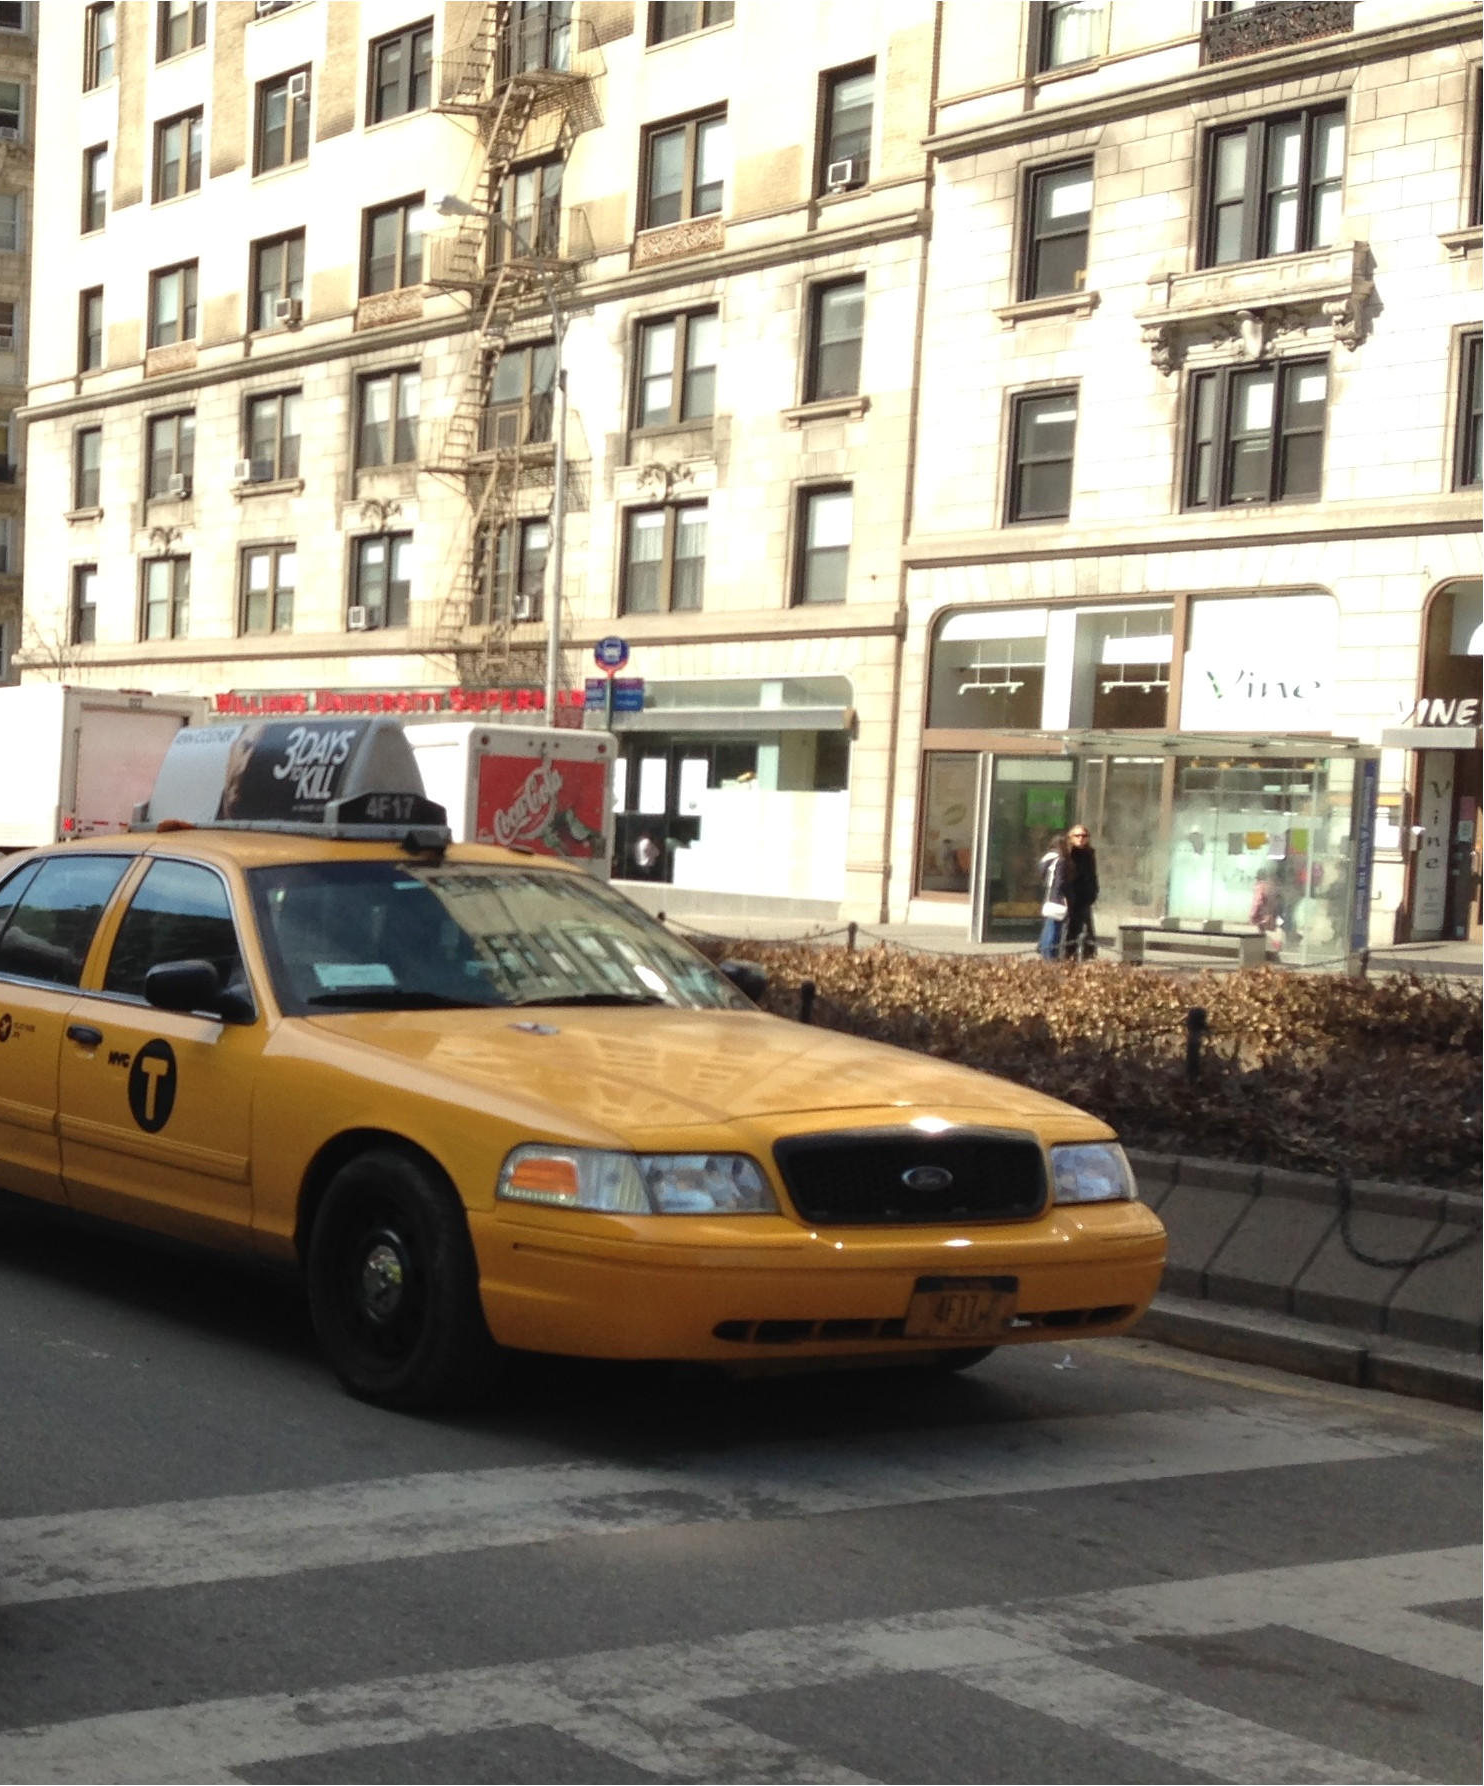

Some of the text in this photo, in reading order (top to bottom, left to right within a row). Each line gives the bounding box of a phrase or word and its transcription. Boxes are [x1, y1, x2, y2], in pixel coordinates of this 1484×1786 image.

[1205, 669, 1322, 700] Vine
[1396, 697, 1480, 726] VINE
[295, 765, 332, 800] KILL
[365, 797, 415, 820] 4F17
[1424, 779, 1453, 870] Vine
[108, 1051, 131, 1068] NYC
[141, 1056, 169, 1121] T
